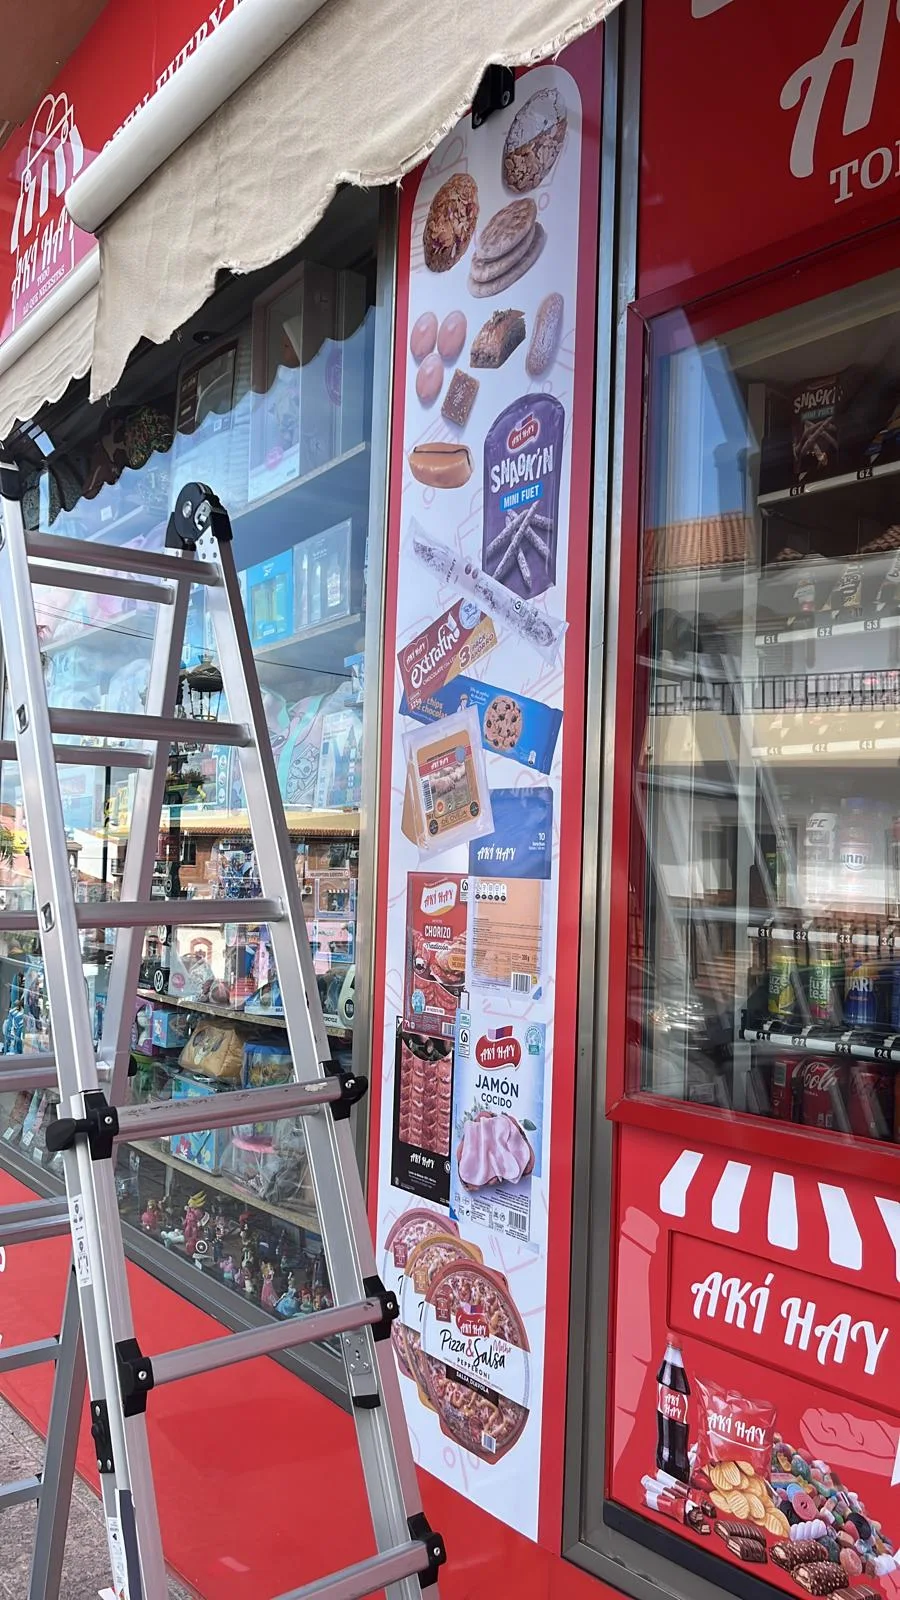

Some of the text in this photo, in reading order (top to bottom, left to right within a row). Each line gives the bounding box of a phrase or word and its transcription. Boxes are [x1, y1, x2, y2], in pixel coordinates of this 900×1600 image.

[829, 140, 900, 204] TO
[859, 469, 871, 479] 62
[503, 484, 540, 509] MINI FUET
[866, 620, 878, 630] 53
[819, 627, 831, 637] 52
[765, 635, 777, 644] 51
[814, 743, 826, 753] 42
[424, 925, 451, 939] CHORIZO
[760, 928, 770, 937] 31
[795, 931, 807, 941] 32
[839, 934, 851, 944] 33
[882, 936, 893, 946] 34
[758, 1032, 768, 1041] 21
[793, 1037, 805, 1046] 22
[480, 1043, 496, 1063] AKÍ
[496, 1044, 516, 1060] HAY
[837, 1043, 849, 1053] 23
[877, 1049, 888, 1059] 24
[475, 1074, 519, 1098] JAMÓN
[481, 1092, 512, 1109] COCIDO
[690, 1271, 889, 1376] AKÍ HAY
[440, 1328, 506, 1369] Pizza & Salsa
[456, 1356, 490, 1380] PEPPERONI
[664, 1393, 681, 1407] AKÍ
[664, 1403, 682, 1419] HAY
[706, 1412, 766, 1446] AKÍ HAY
